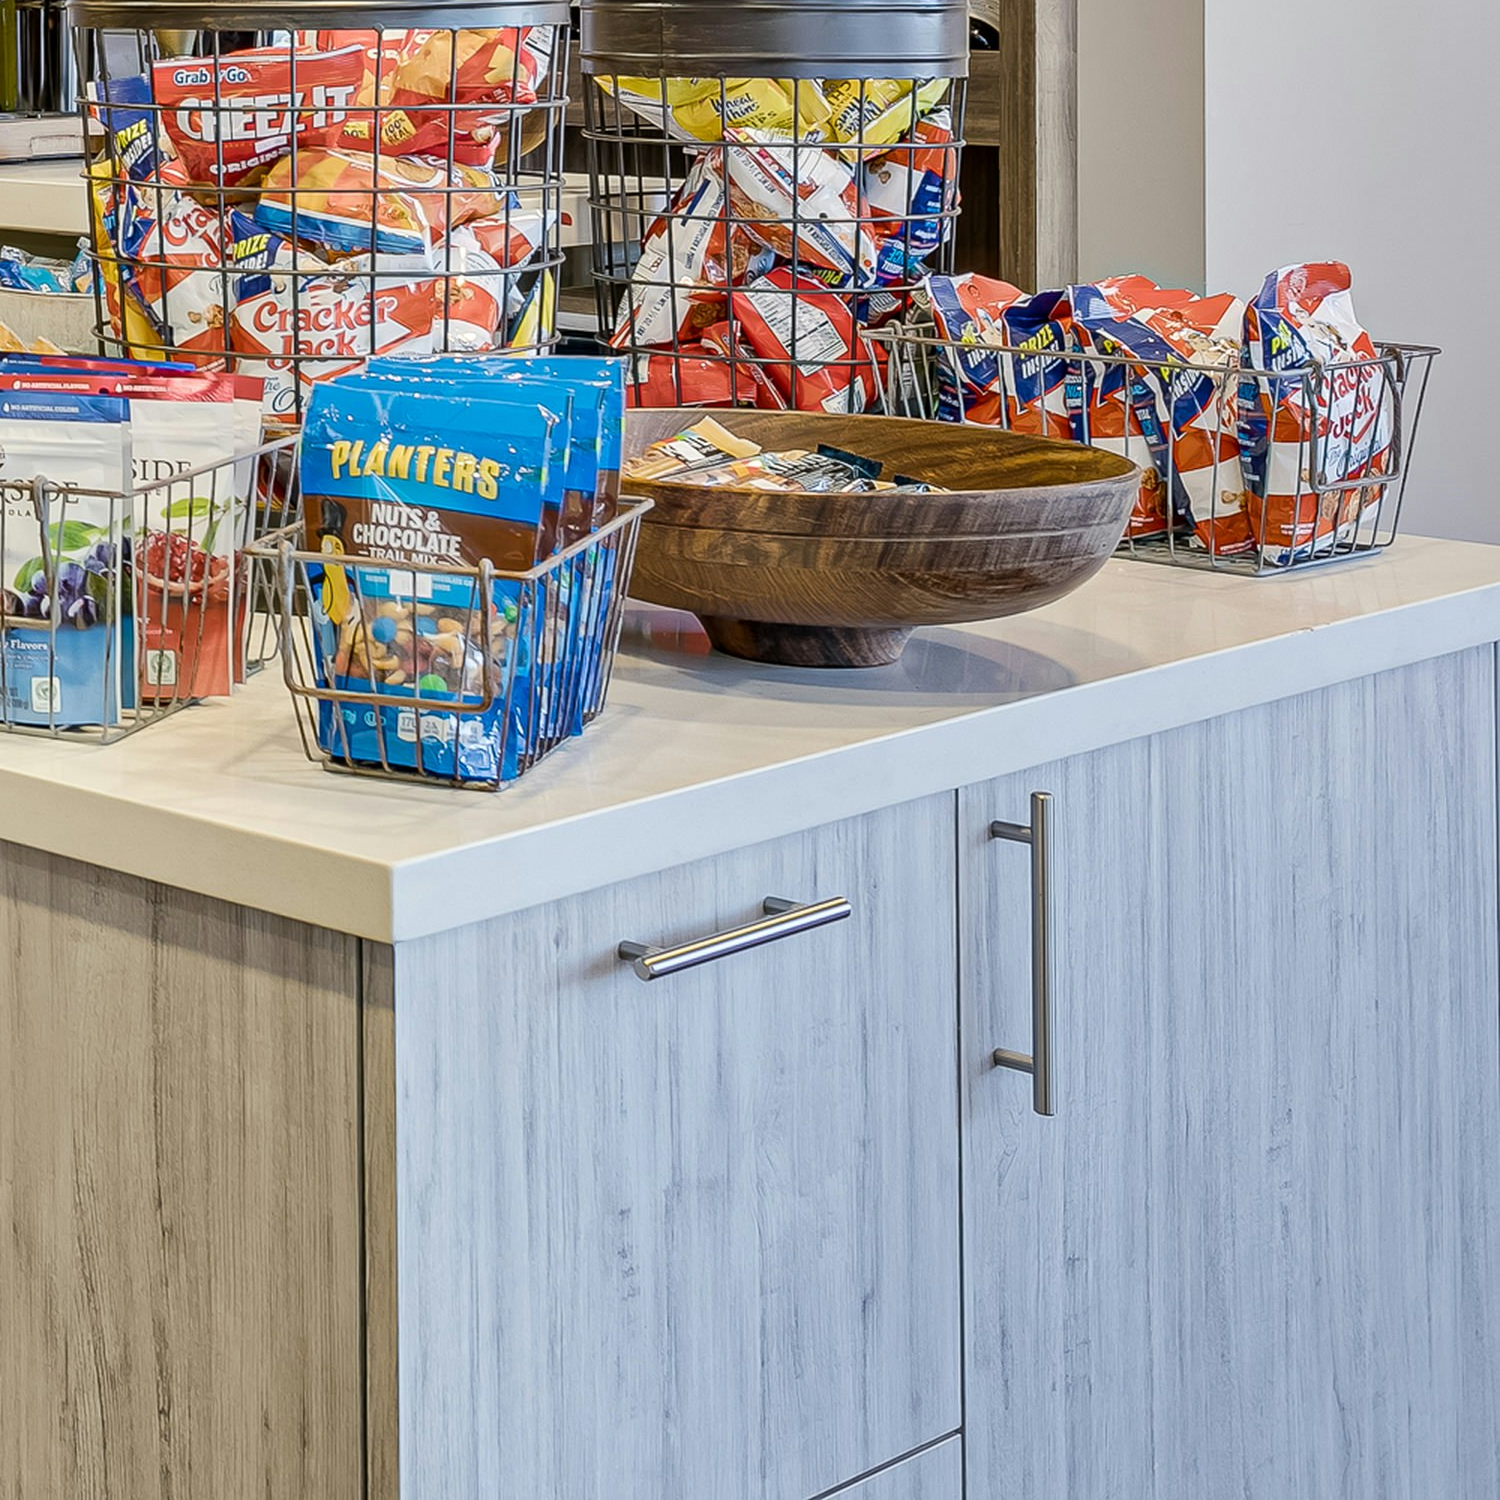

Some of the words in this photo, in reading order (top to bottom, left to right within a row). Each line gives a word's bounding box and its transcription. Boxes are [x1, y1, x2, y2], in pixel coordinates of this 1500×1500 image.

[175, 69, 208, 84] Grab
[226, 67, 247, 82] Go
[384, 117, 406, 136] 100%
[388, 129, 412, 144] REAL
[253, 296, 398, 333] Cracker
[266, 332, 359, 372] Jack
[330, 440, 501, 501] PLANTERS
[371, 503, 424, 529] NUTS
[424, 510, 441, 531] &
[352, 522, 462, 558] CHOCOLATE
[369, 548, 408, 564] TRAIL
[411, 553, 439, 565] MIX
[11, 639, 49, 651] Flavors
